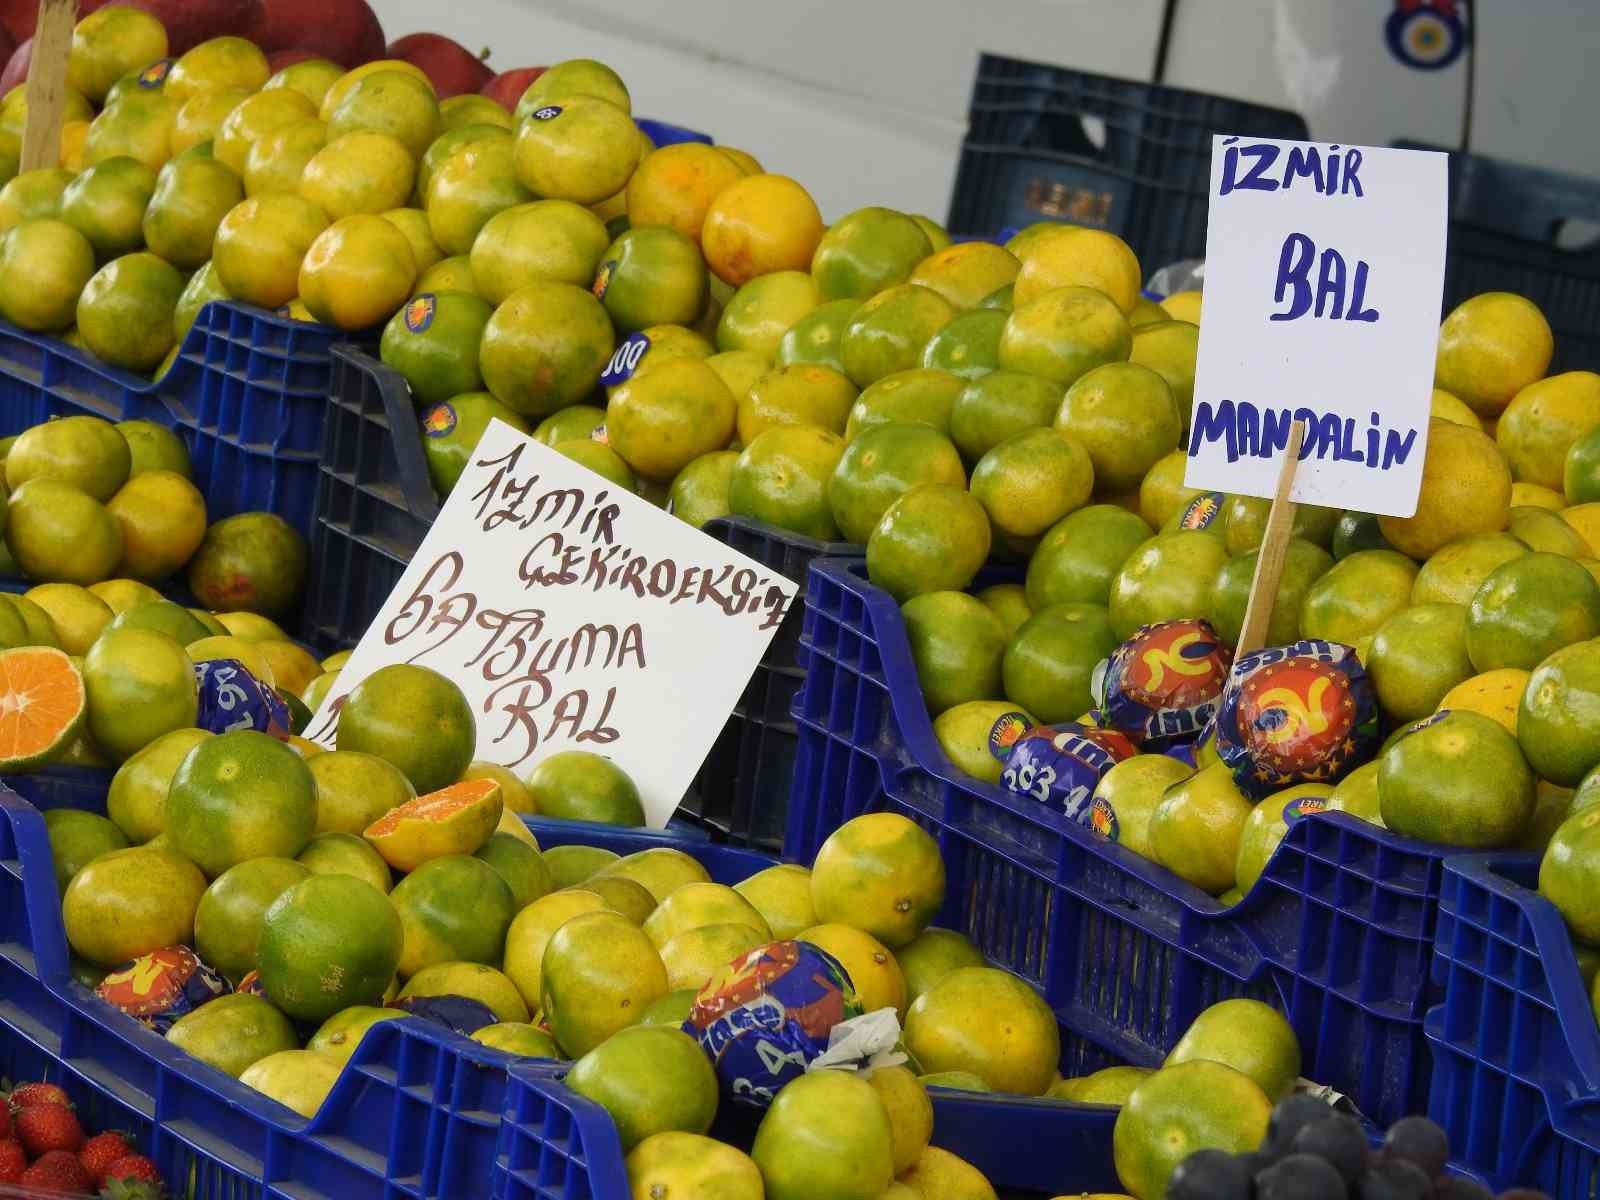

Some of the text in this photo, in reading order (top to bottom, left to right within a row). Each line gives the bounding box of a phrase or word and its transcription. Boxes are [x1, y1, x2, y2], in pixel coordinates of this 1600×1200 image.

[1219, 137, 1364, 197] İZMİR
[1270, 232, 1380, 322] BAL
[384, 551, 647, 681] SATSUMA
[483, 675, 621, 769] BAL
